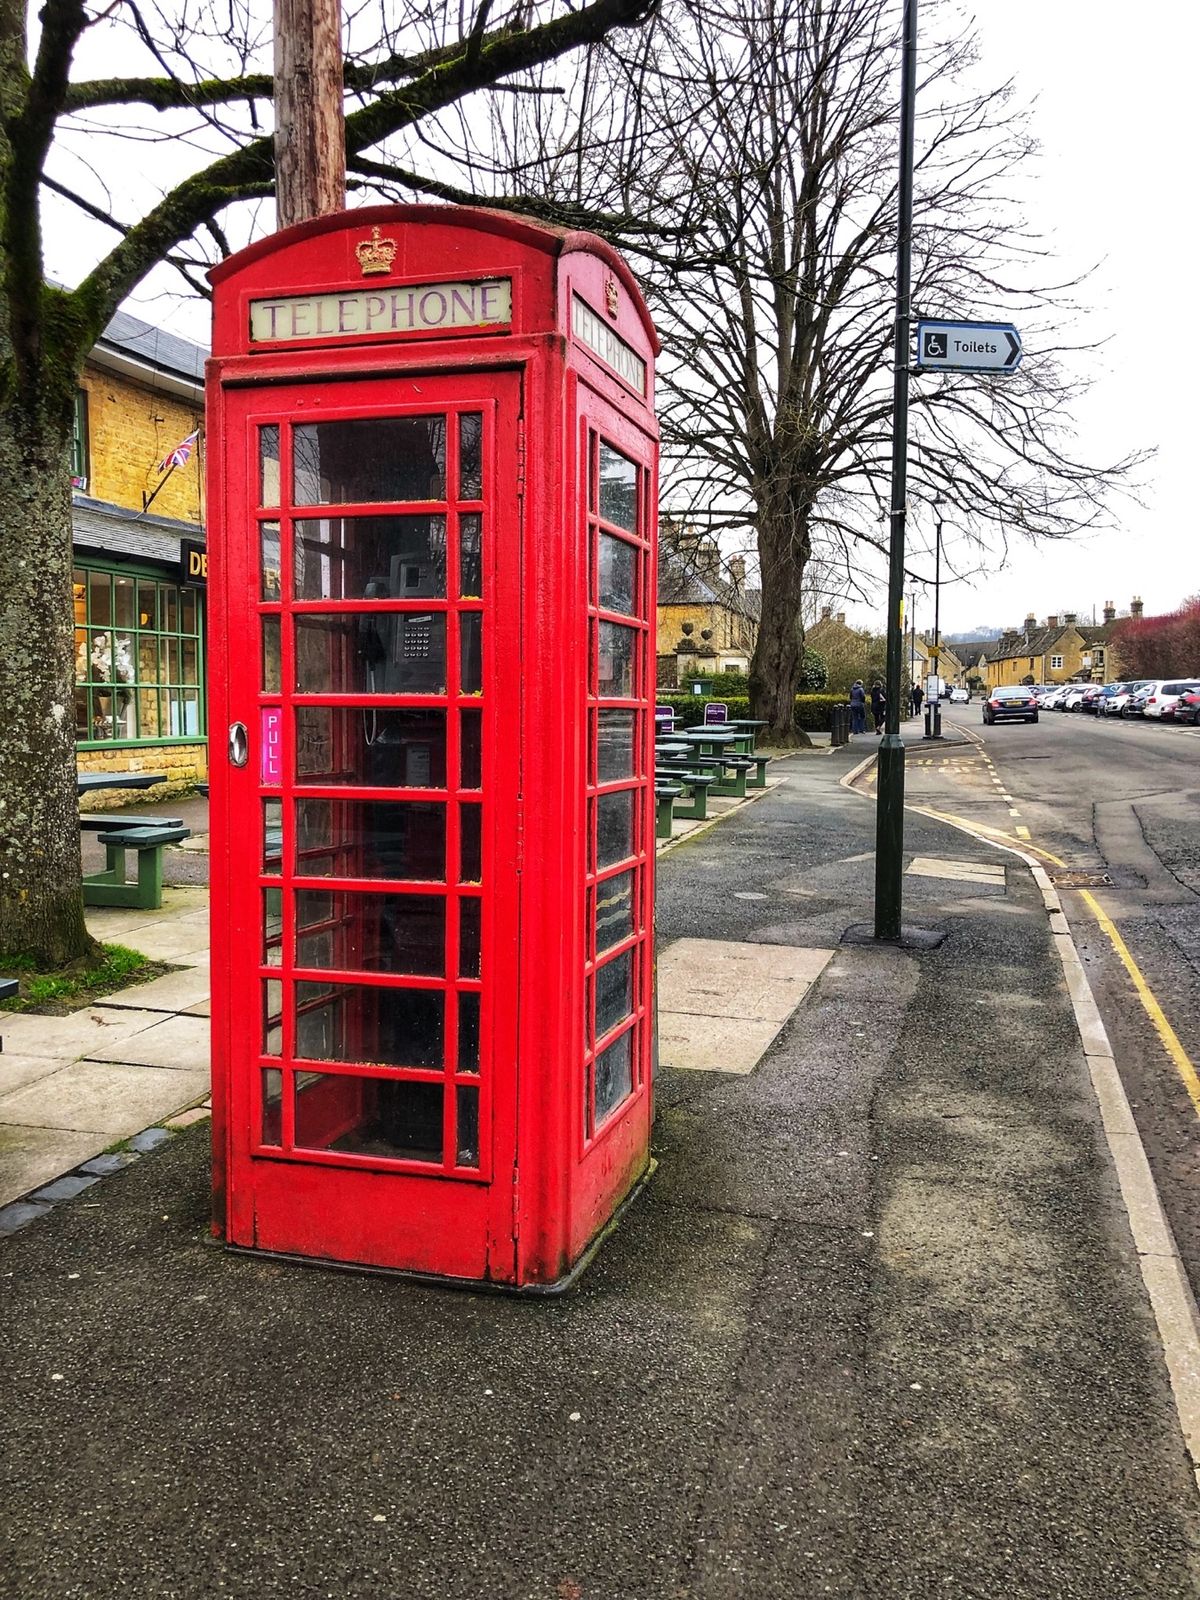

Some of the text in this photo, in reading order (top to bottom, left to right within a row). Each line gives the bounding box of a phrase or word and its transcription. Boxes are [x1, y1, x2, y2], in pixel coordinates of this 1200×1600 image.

[262, 285, 501, 338] TELEPHONE
[571, 300, 644, 392] TELEPHONE
[954, 341, 997, 353] Toilets
[268, 715, 278, 774] PULL
